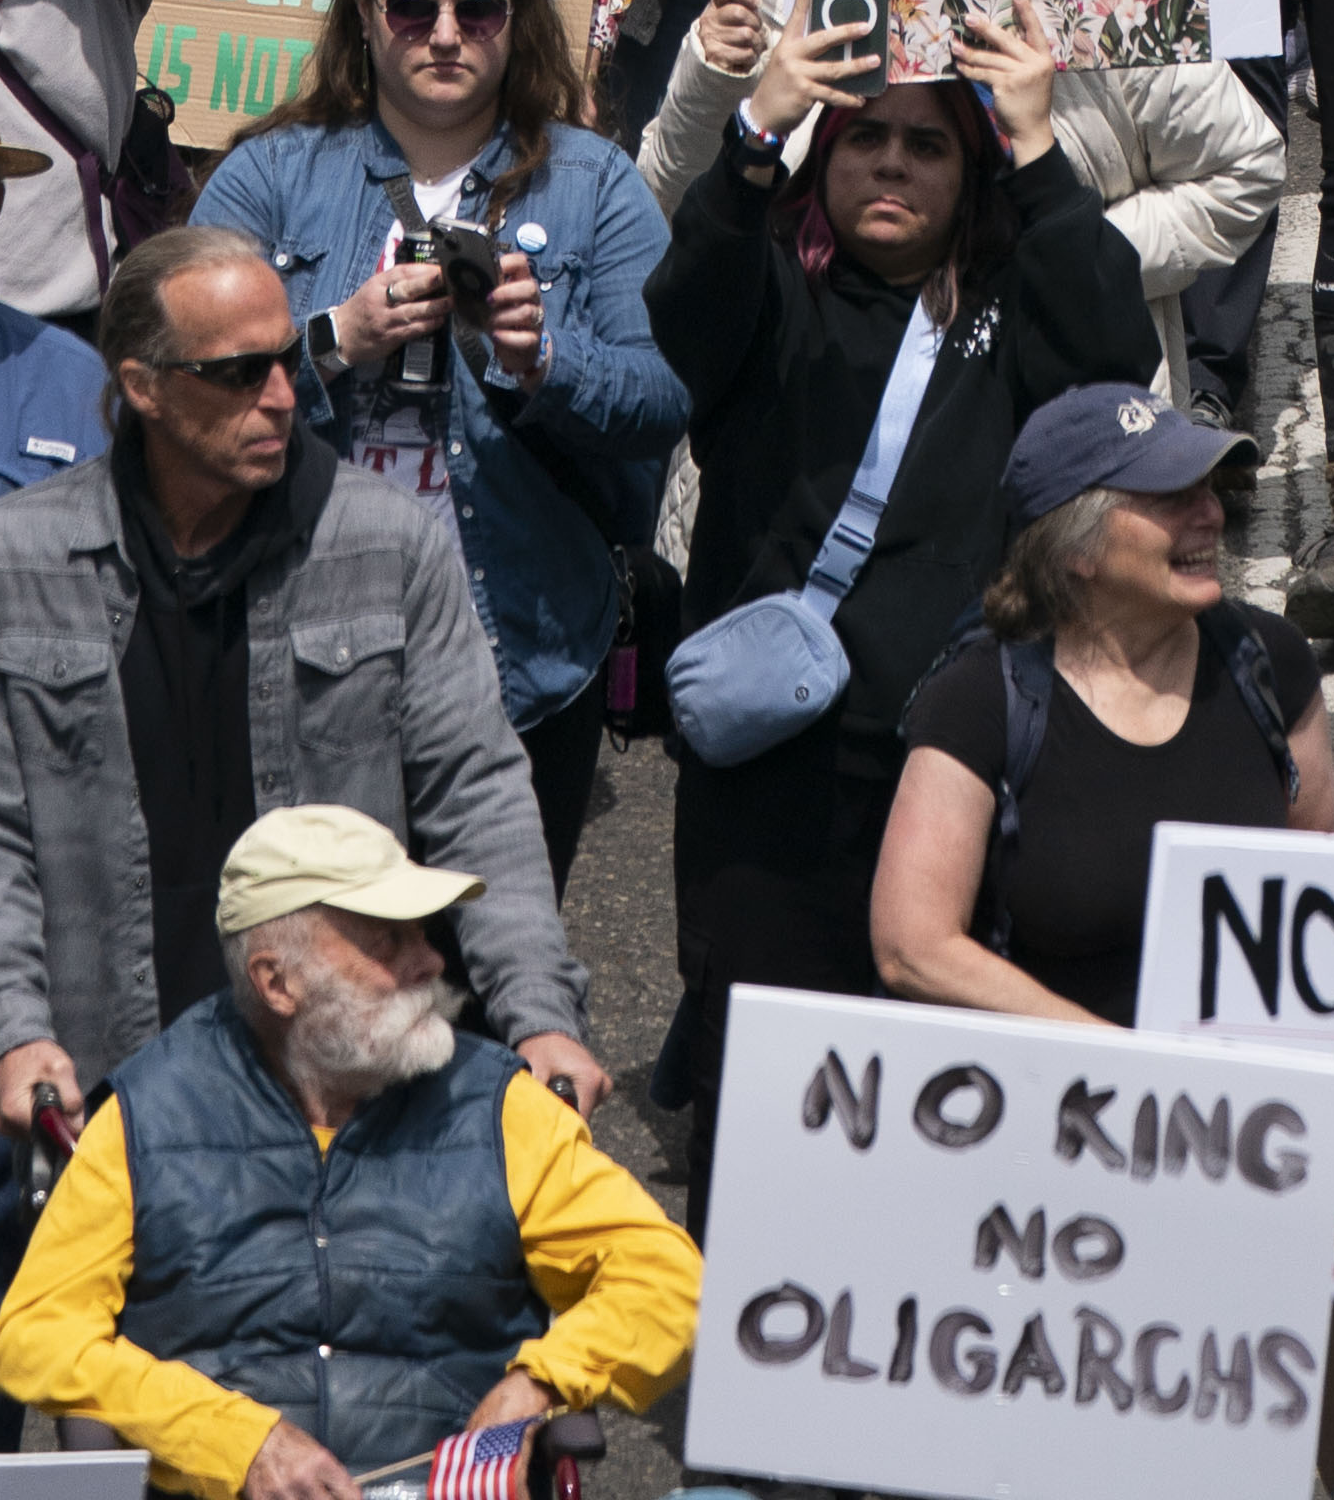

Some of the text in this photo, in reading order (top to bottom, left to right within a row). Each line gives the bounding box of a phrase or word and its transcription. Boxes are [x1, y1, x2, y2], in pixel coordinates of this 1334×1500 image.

[802, 1046, 1309, 1194] NO KING
[973, 1200, 1126, 1281] NO
[736, 1279, 1318, 1428] OLIGARCHS
